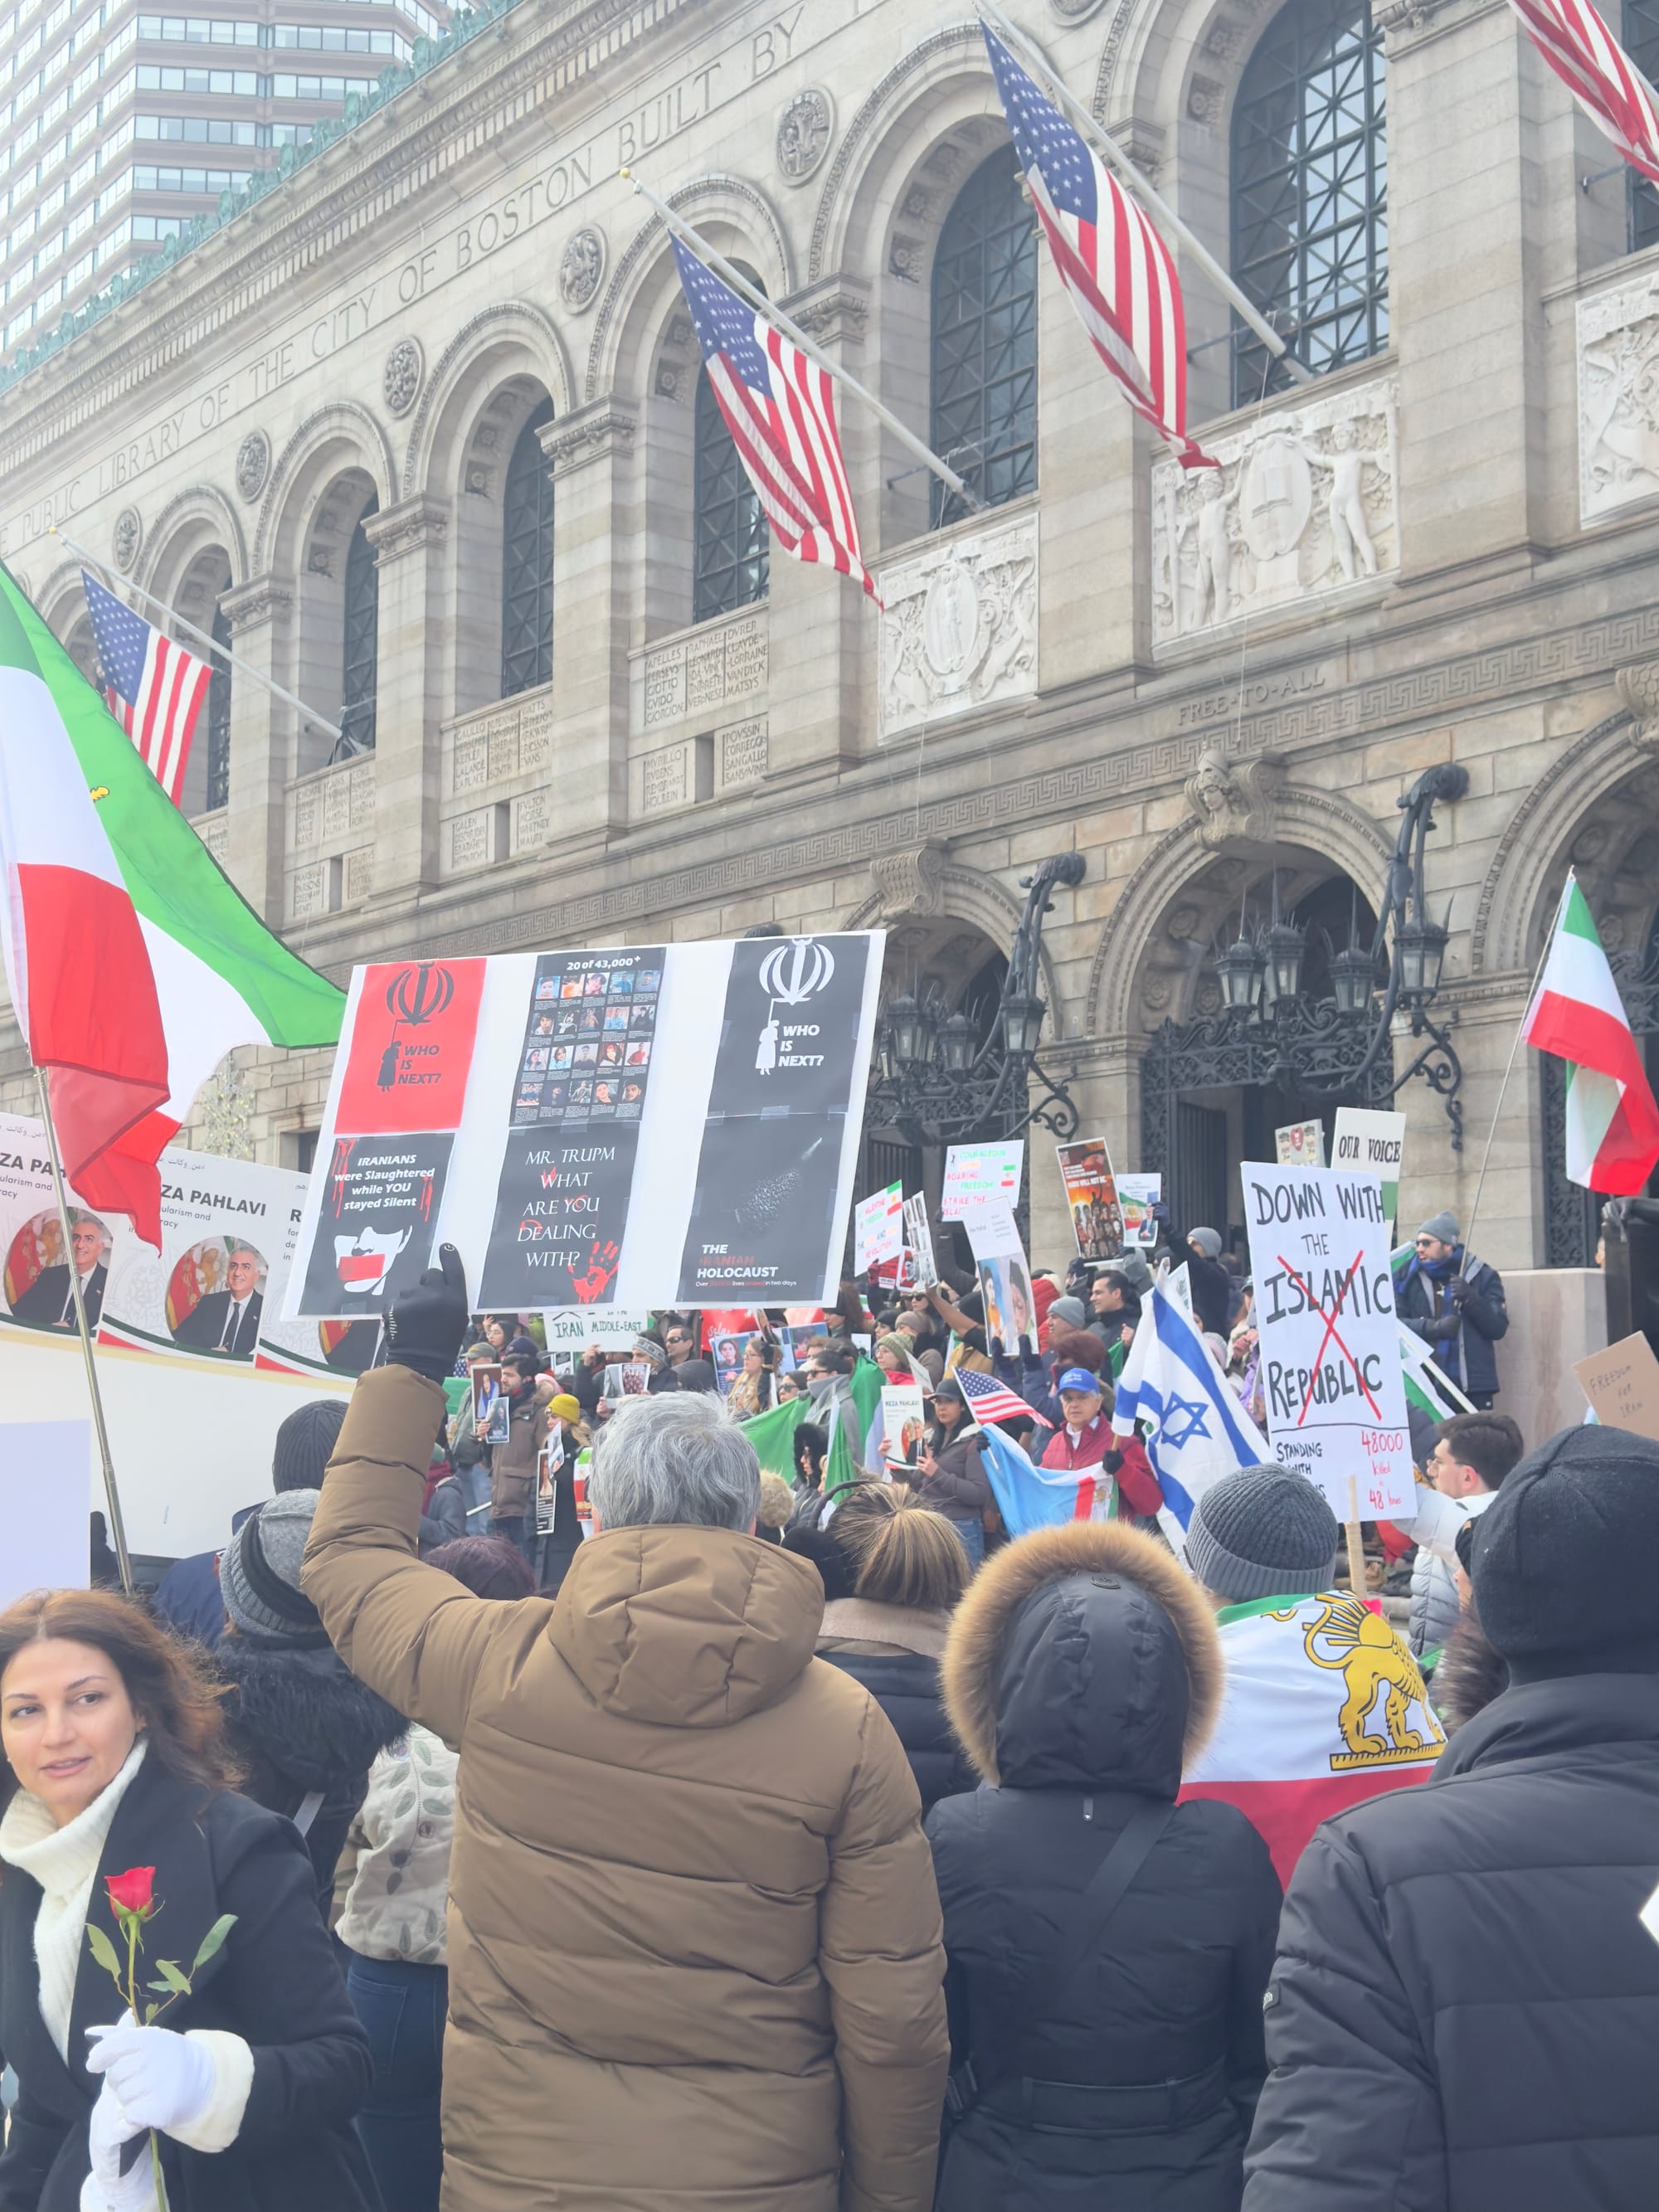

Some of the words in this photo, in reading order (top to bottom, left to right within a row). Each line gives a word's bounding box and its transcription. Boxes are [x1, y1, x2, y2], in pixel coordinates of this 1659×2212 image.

[23, 481, 80, 543] PUBLIC
[99, 411, 185, 496] LIBRARY
[200, 384, 230, 430] OF
[249, 343, 295, 399] THE
[312, 287, 376, 358] CITY
[399, 250, 437, 303] OF
[457, 147, 591, 270] BOSTON
[618, 62, 722, 165] BUILT
[752, 5, 805, 81] BY
[566, 961, 581, 970] 20
[582, 960, 593, 970] of
[783, 1024, 820, 1037] WHO
[405, 1045, 440, 1056] WHO
[781, 1040, 793, 1052] IS
[400, 1060, 412, 1070] IS
[778, 1055, 825, 1067] NEXT?
[398, 1073, 441, 1084] NEXT?
[525, 1150, 555, 1165] MR.
[561, 1146, 615, 1163] TRUPM
[1339, 1135, 1360, 1159] OUR
[1368, 1139, 1401, 1163] VOICE
[0, 1153, 23, 1170] ZA
[358, 1155, 417, 1166] IRANIANS
[0, 1174, 33, 1188] ularism
[35, 1183, 52, 1191] and
[334, 1173, 362, 1182] were
[365, 1168, 435, 1181] Slaughtered
[541, 1172, 593, 1189] WHAT
[946, 1171, 979, 1181] ROARING
[352, 1185, 382, 1195] while
[386, 1183, 411, 1194] YOU
[161, 1184, 184, 1201] ZA
[190, 1189, 266, 1217] PAHLAVI
[343, 1198, 382, 1212] stayed
[383, 1197, 417, 1208] Silent
[523, 1200, 559, 1217] ARE
[564, 1197, 600, 1213] YOU
[943, 1196, 969, 1206] STRIKE
[973, 1195, 986, 1204] THE
[1251, 1182, 1326, 1225] DOWN
[1336, 1183, 1385, 1223] WITH
[162, 1205, 192, 1218] ularism
[942, 1208, 961, 1216] ISLA
[161, 1220, 178, 1229] racy
[518, 1223, 596, 1242] DEALING
[702, 1244, 728, 1254] THE
[1301, 1233, 1330, 1256] THE
[526, 1251, 581, 1267] WITH?
[697, 1266, 778, 1278] HOLOCAUST
[1264, 1266, 1392, 1325] ISLAMIC
[554, 1320, 585, 1338] IRAN
[591, 1320, 642, 1332] MIDDLE-EAST
[1267, 1354, 1383, 1419] REPUBLIC
[1361, 1430, 1404, 1456] 48000
[1276, 1441, 1323, 1463] STANDING
[1370, 1489, 1384, 1510] 48
